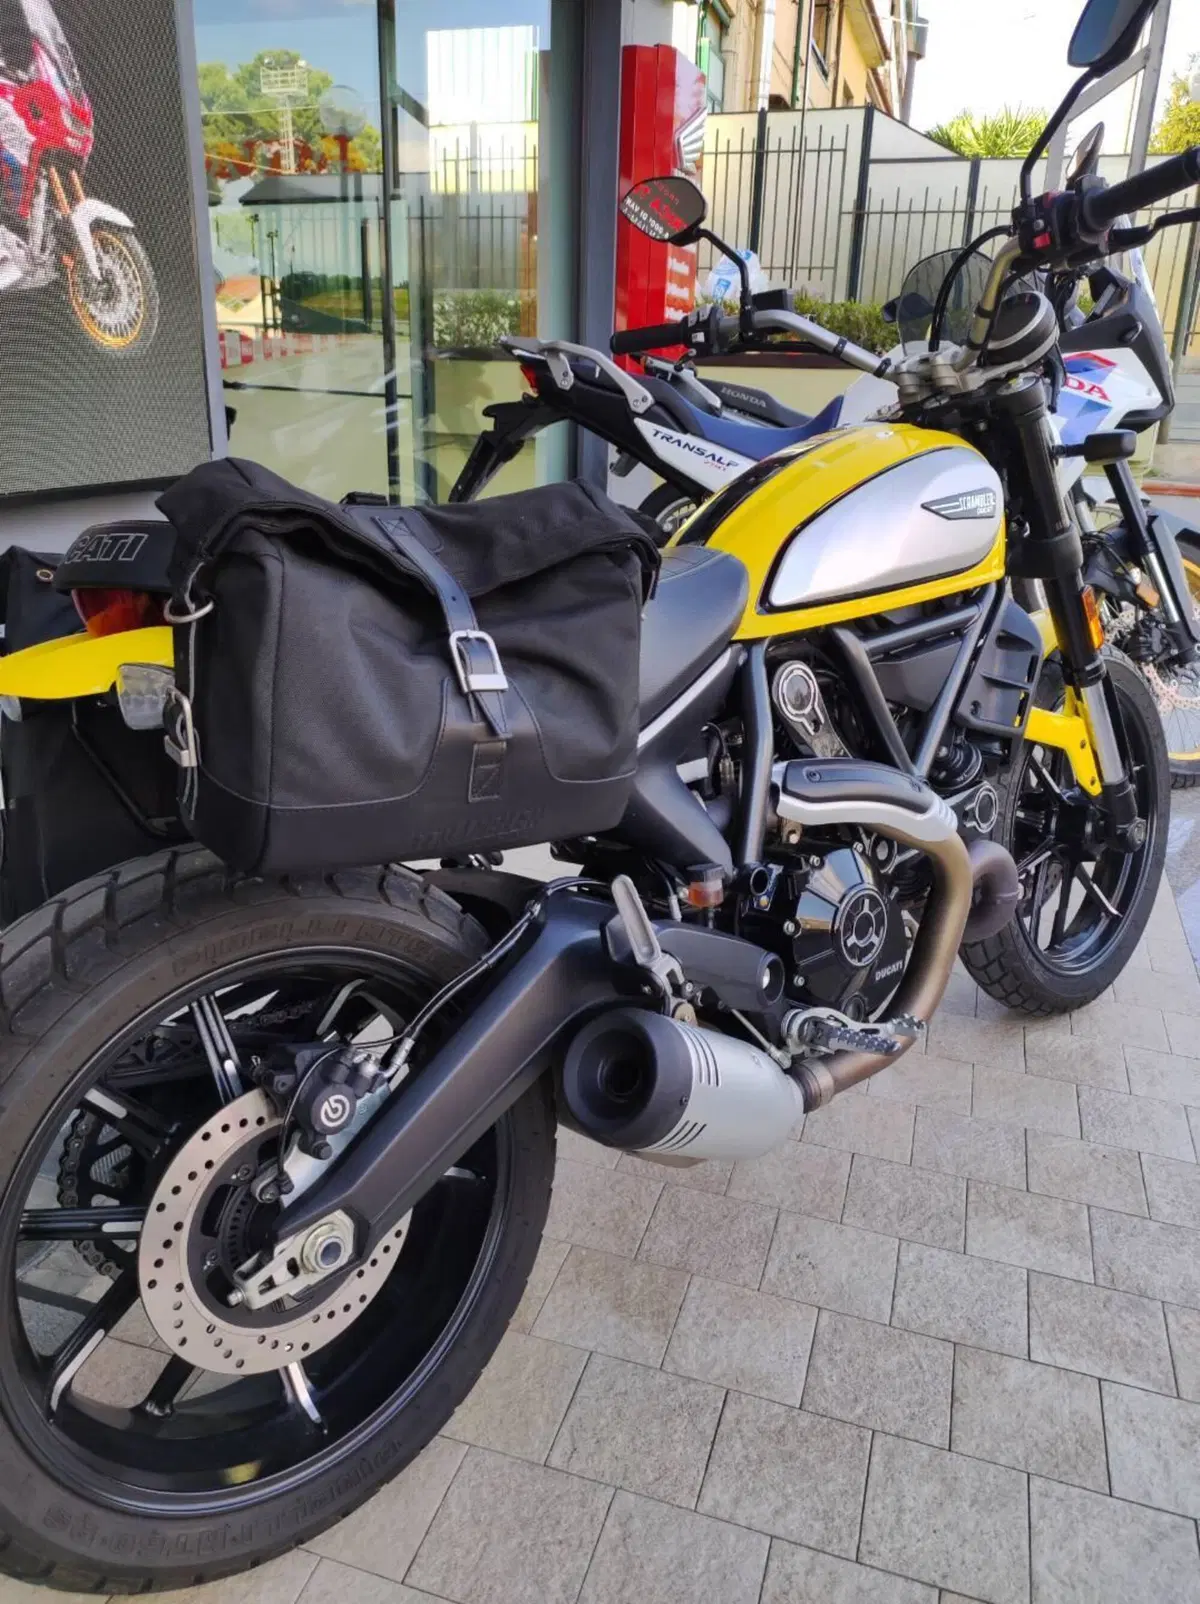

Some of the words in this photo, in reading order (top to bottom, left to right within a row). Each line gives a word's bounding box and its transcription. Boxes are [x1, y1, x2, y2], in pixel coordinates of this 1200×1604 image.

[721, 387, 767, 408] HONDA
[1065, 376, 1111, 402] DA
[652, 428, 740, 468] TRANSALP
[959, 492, 995, 511] SCRAMBLER
[68, 533, 149, 563] CATI
[875, 960, 903, 981] DUCATI
